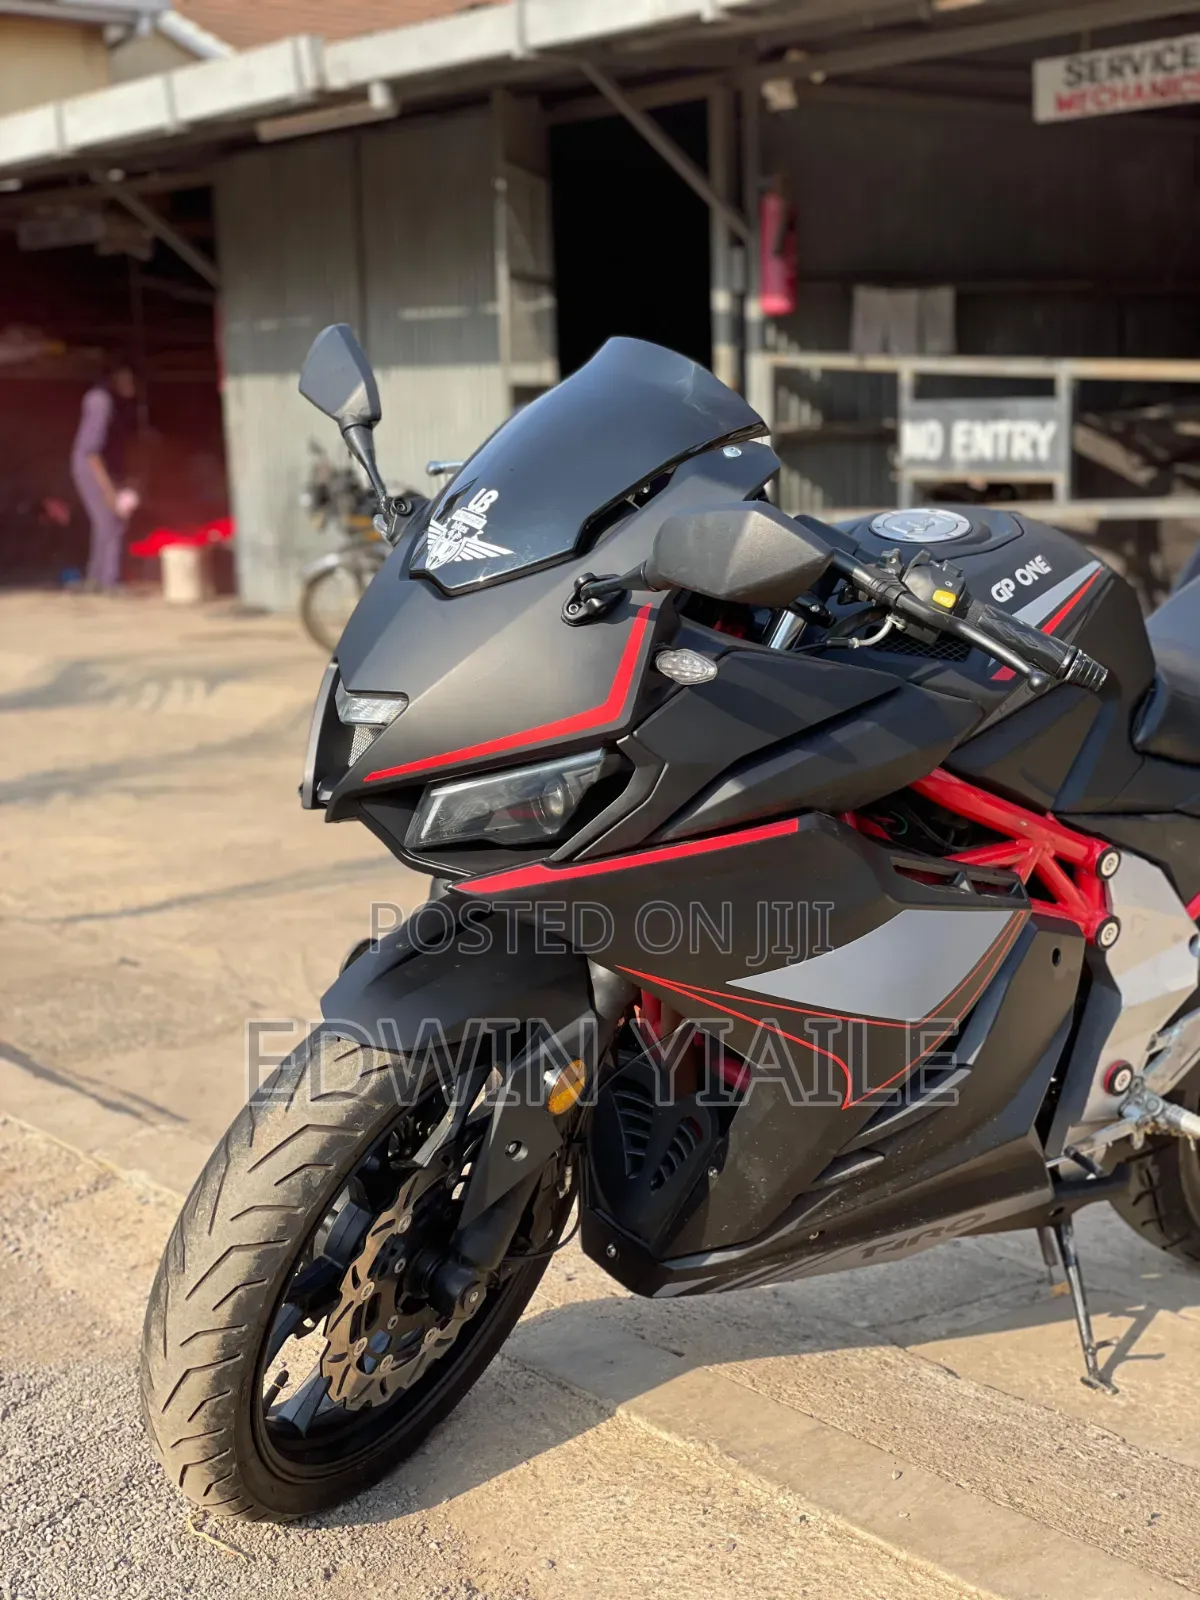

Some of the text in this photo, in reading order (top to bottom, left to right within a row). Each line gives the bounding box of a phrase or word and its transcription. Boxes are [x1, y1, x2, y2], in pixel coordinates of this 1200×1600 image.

[1063, 41, 1200, 87] SERVICE
[902, 418, 1058, 462] NO ENTRY
[990, 554, 1052, 603] GP ONE
